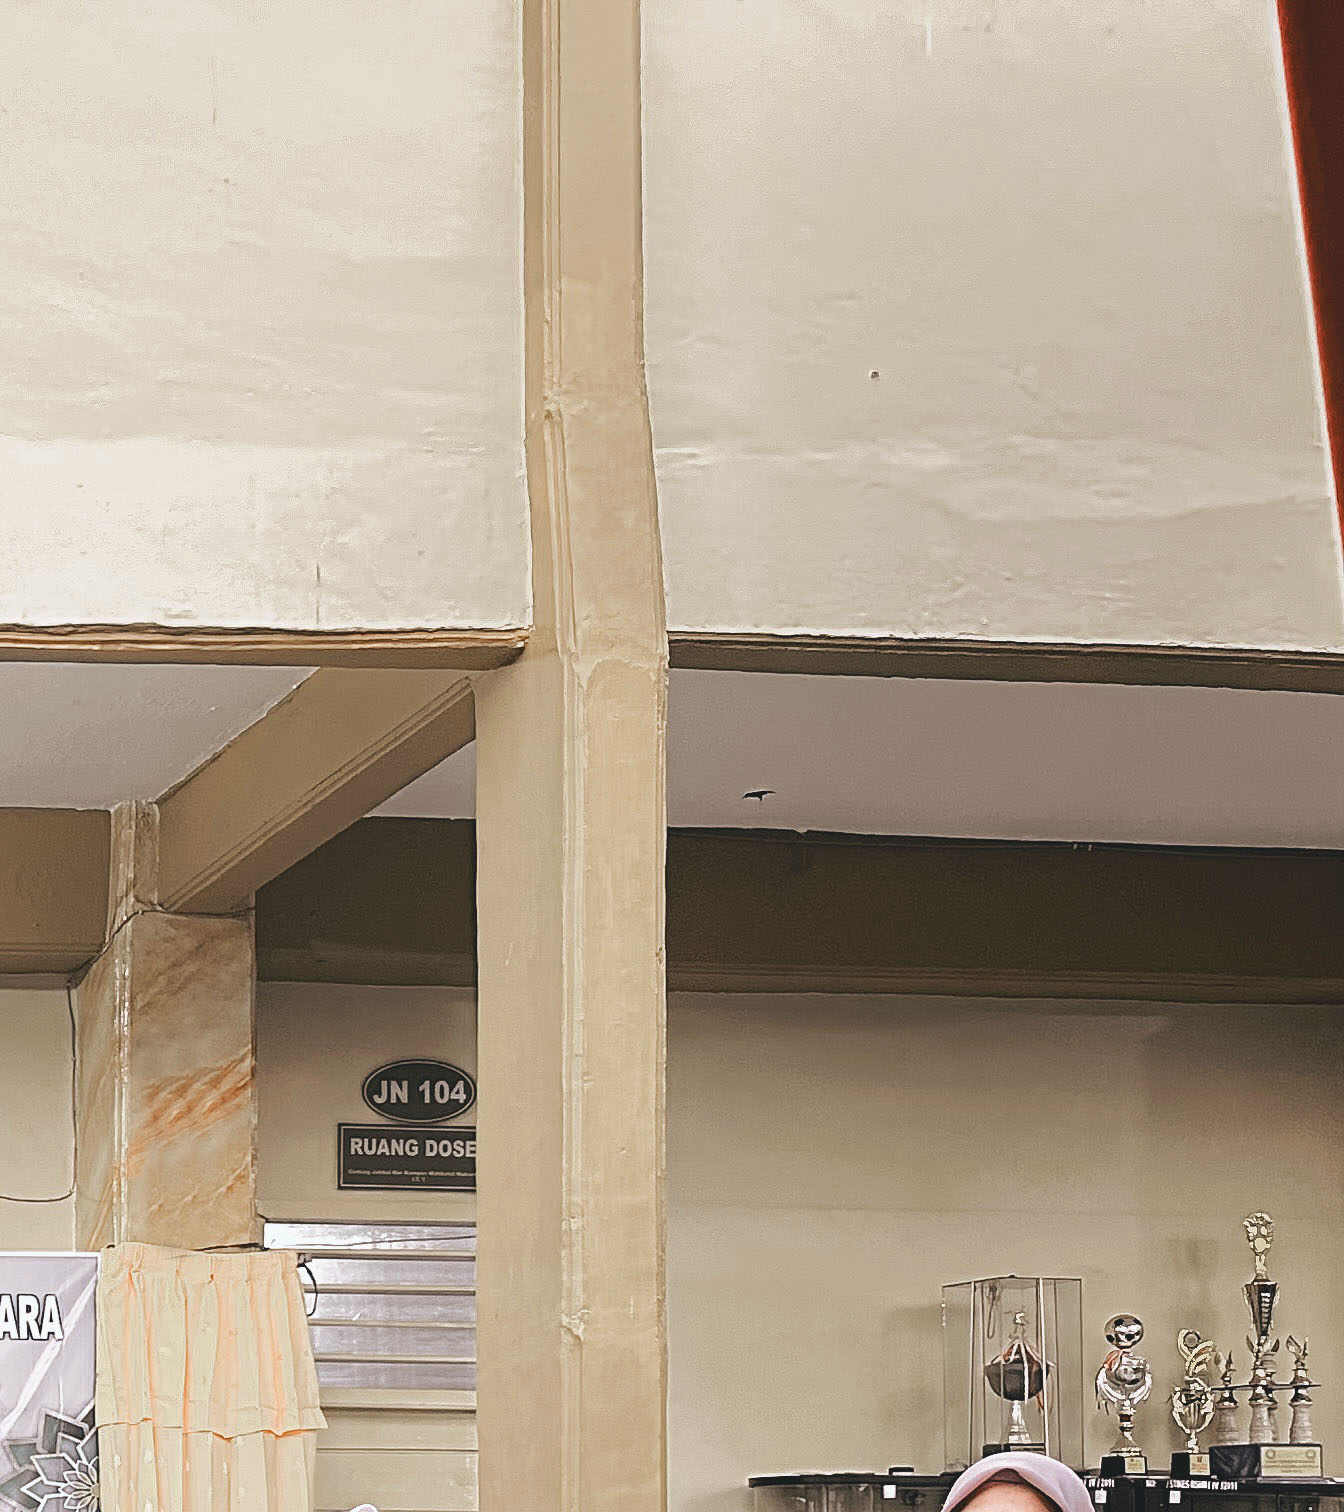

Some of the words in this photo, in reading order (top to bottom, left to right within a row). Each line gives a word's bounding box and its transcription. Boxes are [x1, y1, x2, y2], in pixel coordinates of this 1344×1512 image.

[373, 1080, 408, 1103] JN
[418, 1080, 466, 1104] 104
[350, 1137, 419, 1157] RUANG
[425, 1140, 476, 1157] DOSE
